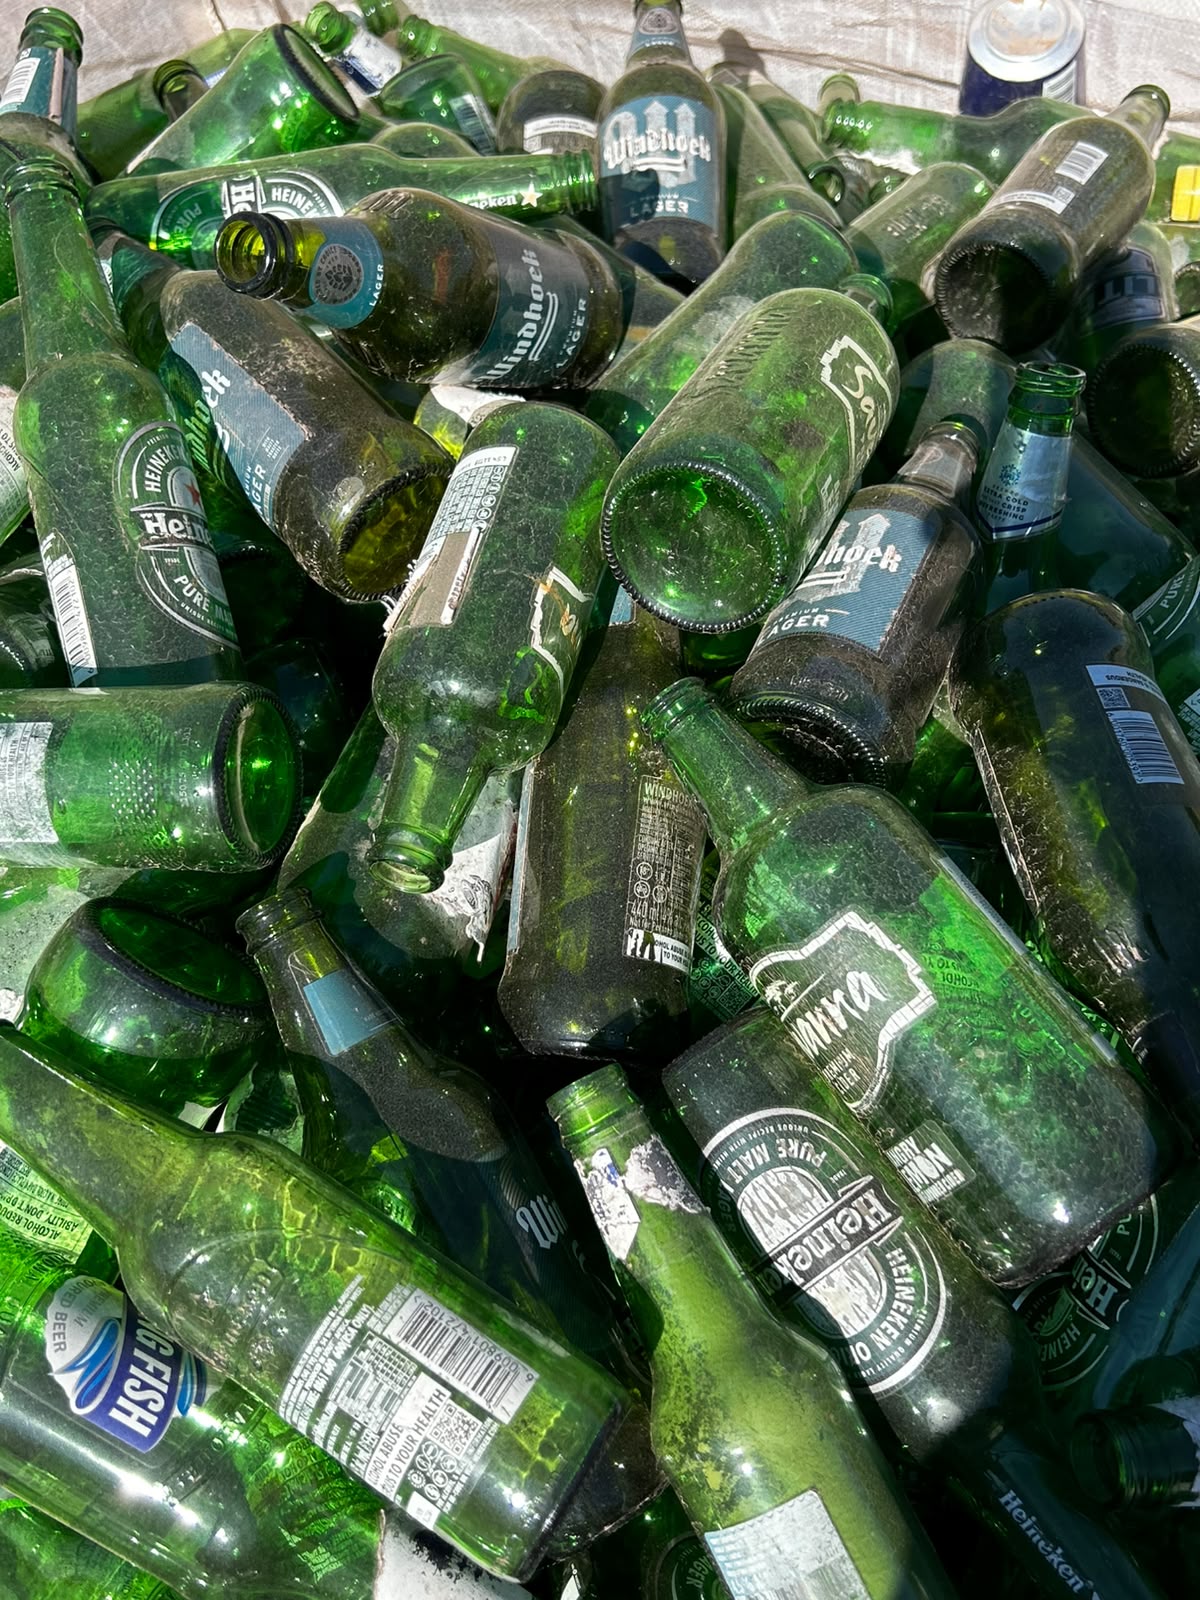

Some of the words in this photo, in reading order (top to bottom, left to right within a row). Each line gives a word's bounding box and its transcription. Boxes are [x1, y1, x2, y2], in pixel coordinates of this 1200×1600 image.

[630, 200, 689, 217] LAGER
[369, 264, 384, 307] LAGER
[472, 248, 545, 383] Windhoek
[556, 298, 587, 369] LAGER
[984, 486, 1003, 499] EXTRA
[1005, 496, 1029, 507] COLD
[1001, 502, 1028, 513] CRISP
[173, 573, 210, 613] PURE
[1159, 573, 1186, 609] PURE
[630, 899, 648, 919] 440
[704, 940, 718, 956] TO
[728, 1138, 748, 1153] WITH
[749, 1125, 776, 1141] RECIPE
[777, 1123, 809, 1134] UNIQUE
[726, 1141, 771, 1185] MALT
[778, 1137, 828, 1169] PURE
[24, 1220, 61, 1240] ALCOHOL
[46, 1211, 80, 1232] ABILITY,
[869, 1247, 914, 1352] HEINEKEN
[52, 1310, 69, 1354] BEER
[422, 1302, 470, 1336] 472102
[473, 1335, 519, 1373] 009801
[108, 1346, 172, 1439] FISH
[525, 1372, 535, 1383] 6
[379, 1422, 404, 1459] ABUSE
[395, 1434, 419, 1466] YOUR
[411, 1388, 447, 1436] HEALTH
[999, 1489, 1086, 1594] Heineken
